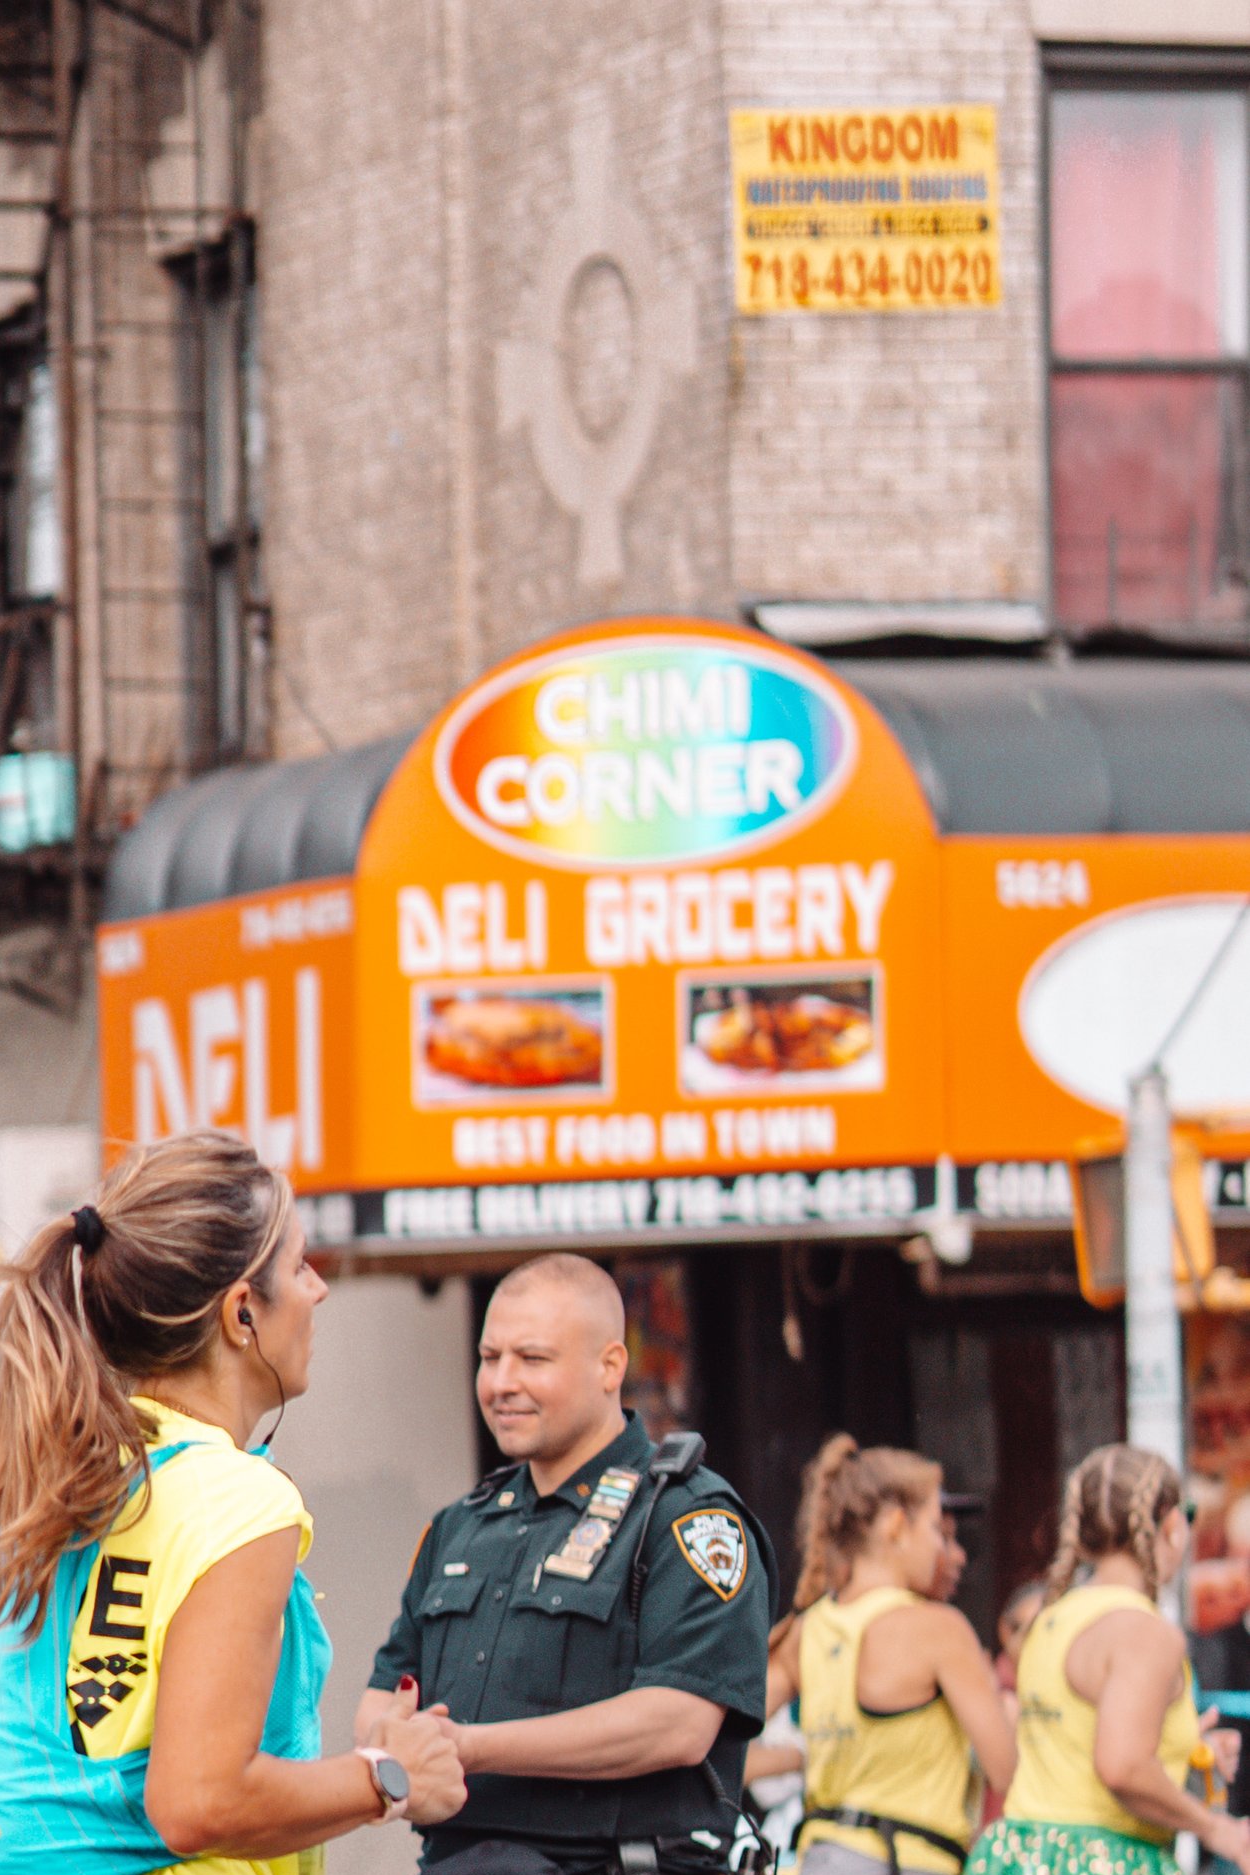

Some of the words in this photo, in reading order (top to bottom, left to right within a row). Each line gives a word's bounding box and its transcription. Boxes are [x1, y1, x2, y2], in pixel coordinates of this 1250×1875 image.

[767, 113, 960, 163] KINGDOM
[745, 249, 991, 304] 718-434-0020
[534, 664, 751, 744] CHIMI
[476, 739, 804, 827] CORNER
[398, 878, 549, 976] DELI
[584, 860, 895, 967] GROCERY
[452, 1116, 548, 1169] BEST
[555, 1112, 657, 1164] FOOD
[661, 1111, 708, 1160] IN
[712, 1106, 838, 1159] TOWN
